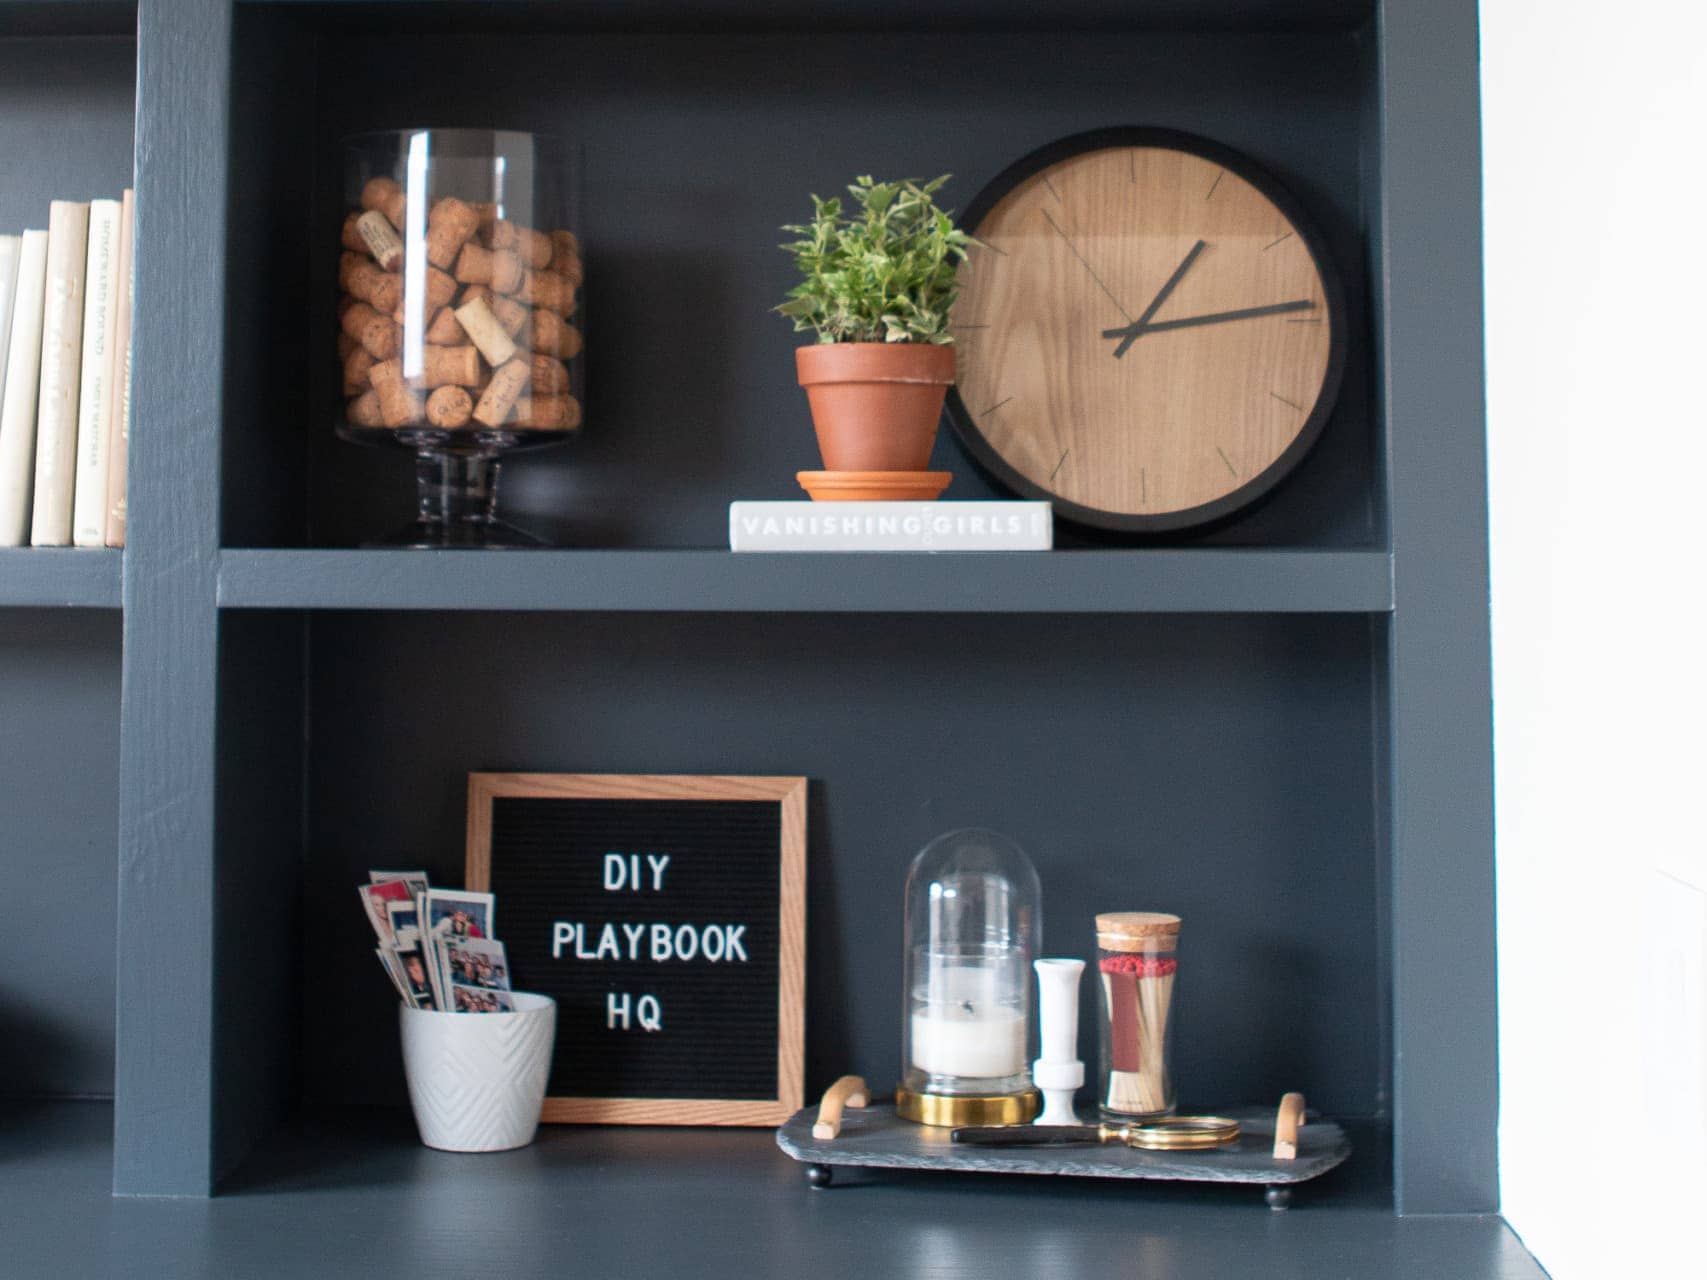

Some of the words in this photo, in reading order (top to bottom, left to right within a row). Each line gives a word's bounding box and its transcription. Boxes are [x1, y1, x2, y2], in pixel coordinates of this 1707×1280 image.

[742, 515, 921, 537] VANISHING
[932, 514, 1021, 536] GIRLS
[603, 854, 670, 891] DIY
[552, 922, 748, 962] PLAYBOOK
[606, 993, 662, 1032] HQ
